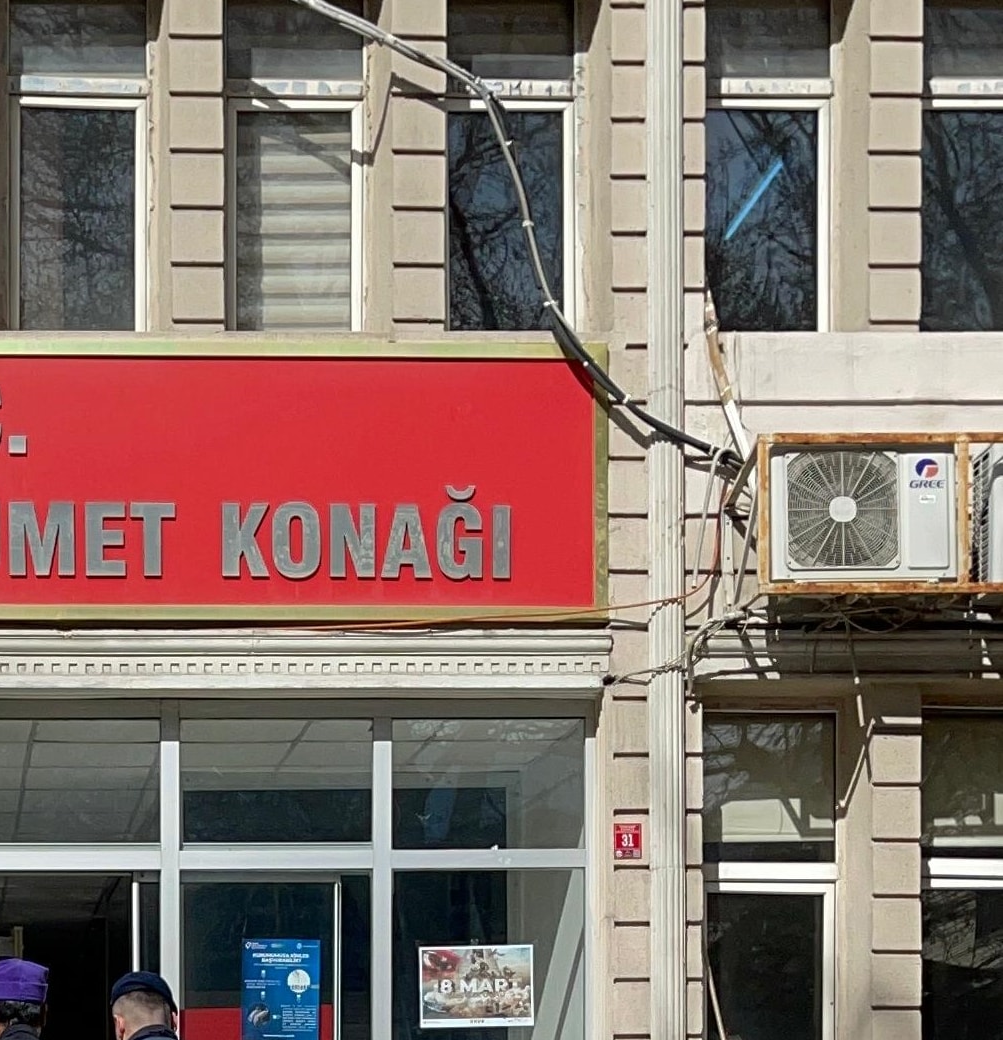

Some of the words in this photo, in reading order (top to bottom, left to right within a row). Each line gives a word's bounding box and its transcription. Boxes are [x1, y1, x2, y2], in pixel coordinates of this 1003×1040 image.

[909, 479, 945, 489] GREE
[220, 484, 512, 582] KONAĞI
[621, 833, 634, 847] 31
[459, 978, 523, 994] MART
